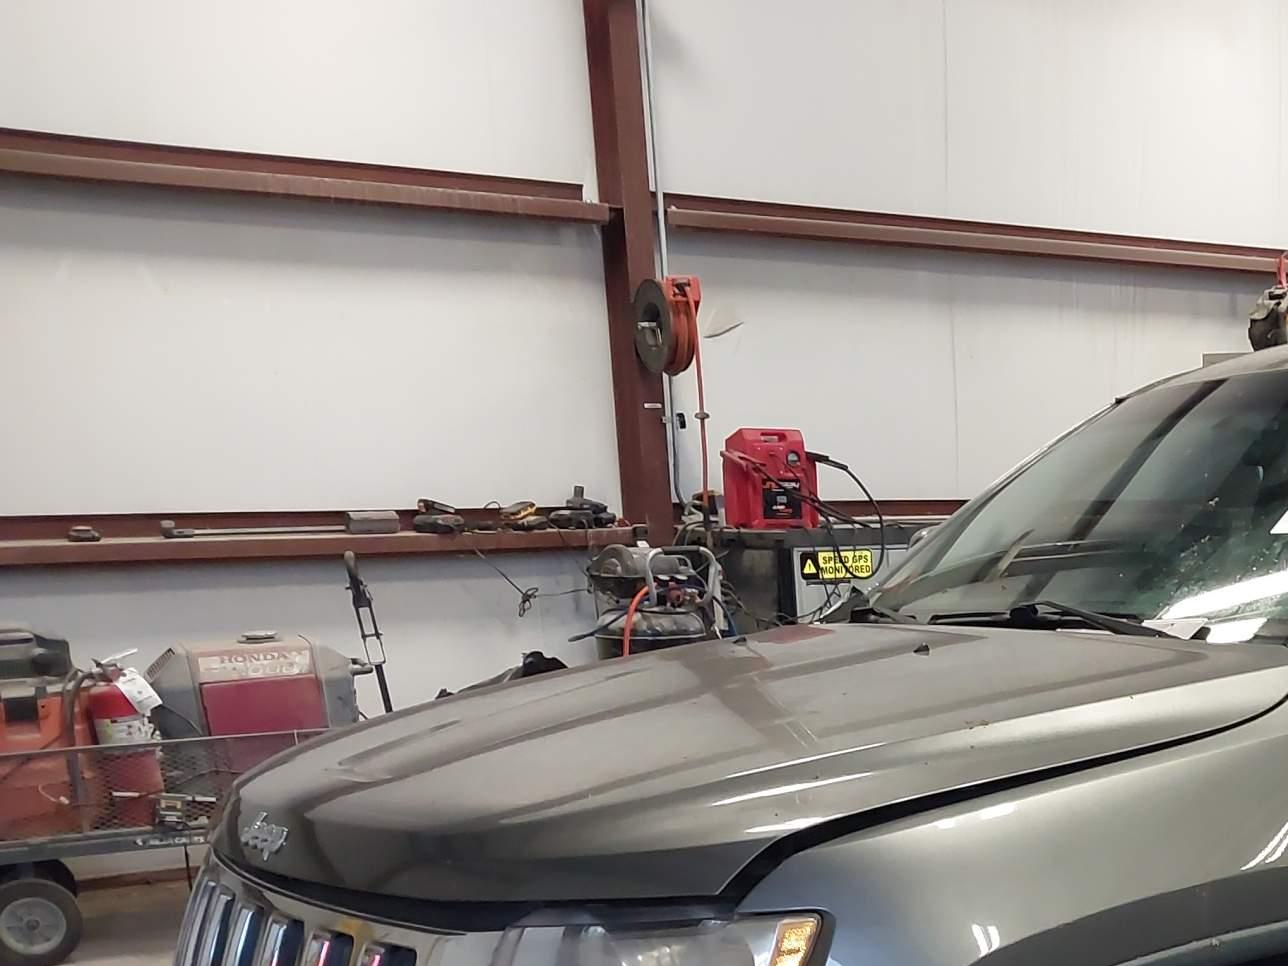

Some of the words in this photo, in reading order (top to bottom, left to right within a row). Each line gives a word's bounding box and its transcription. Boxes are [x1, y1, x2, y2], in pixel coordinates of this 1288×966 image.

[822, 555, 850, 565] SPED
[852, 554, 869, 564] GPS
[820, 564, 871, 575] MONIORED
[220, 651, 289, 665] HONDA
